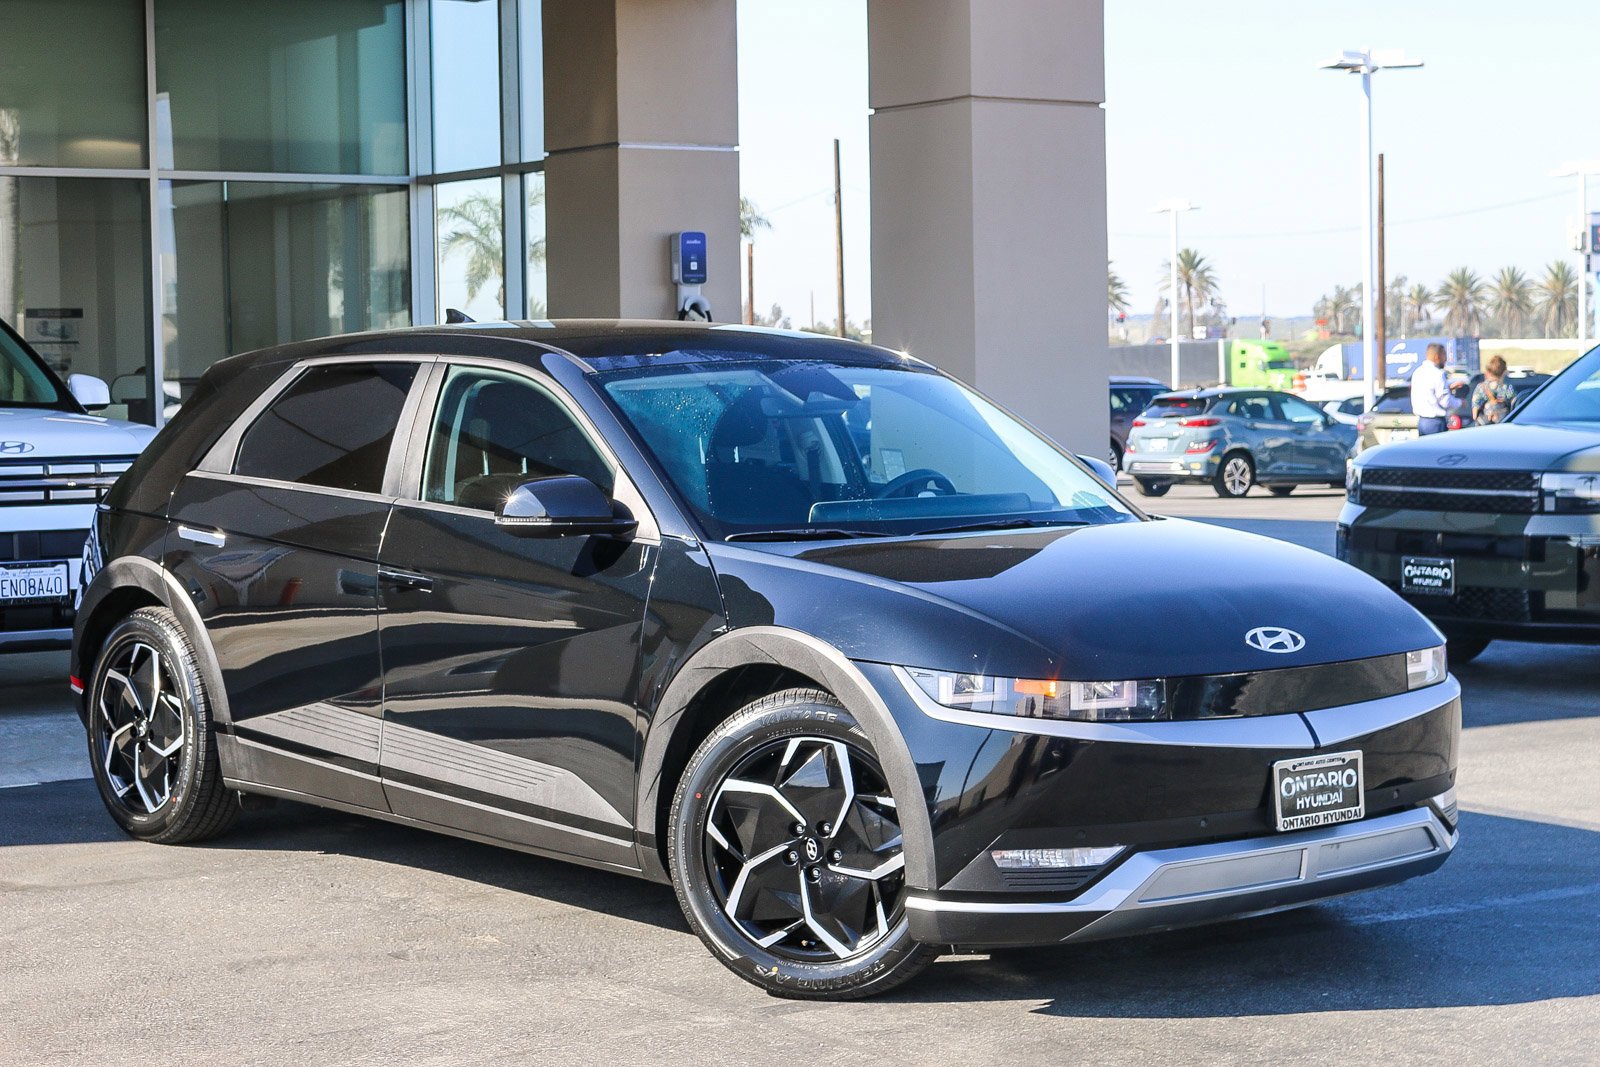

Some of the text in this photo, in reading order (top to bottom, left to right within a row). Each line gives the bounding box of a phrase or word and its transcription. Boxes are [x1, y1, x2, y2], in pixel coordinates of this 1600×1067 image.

[1, 576, 62, 597] EN08A40
[1281, 768, 1357, 797] ONTARIO
[1296, 789, 1343, 810] HYUNDAI
[1282, 808, 1361, 829] ONTARIO HYUNDAI
